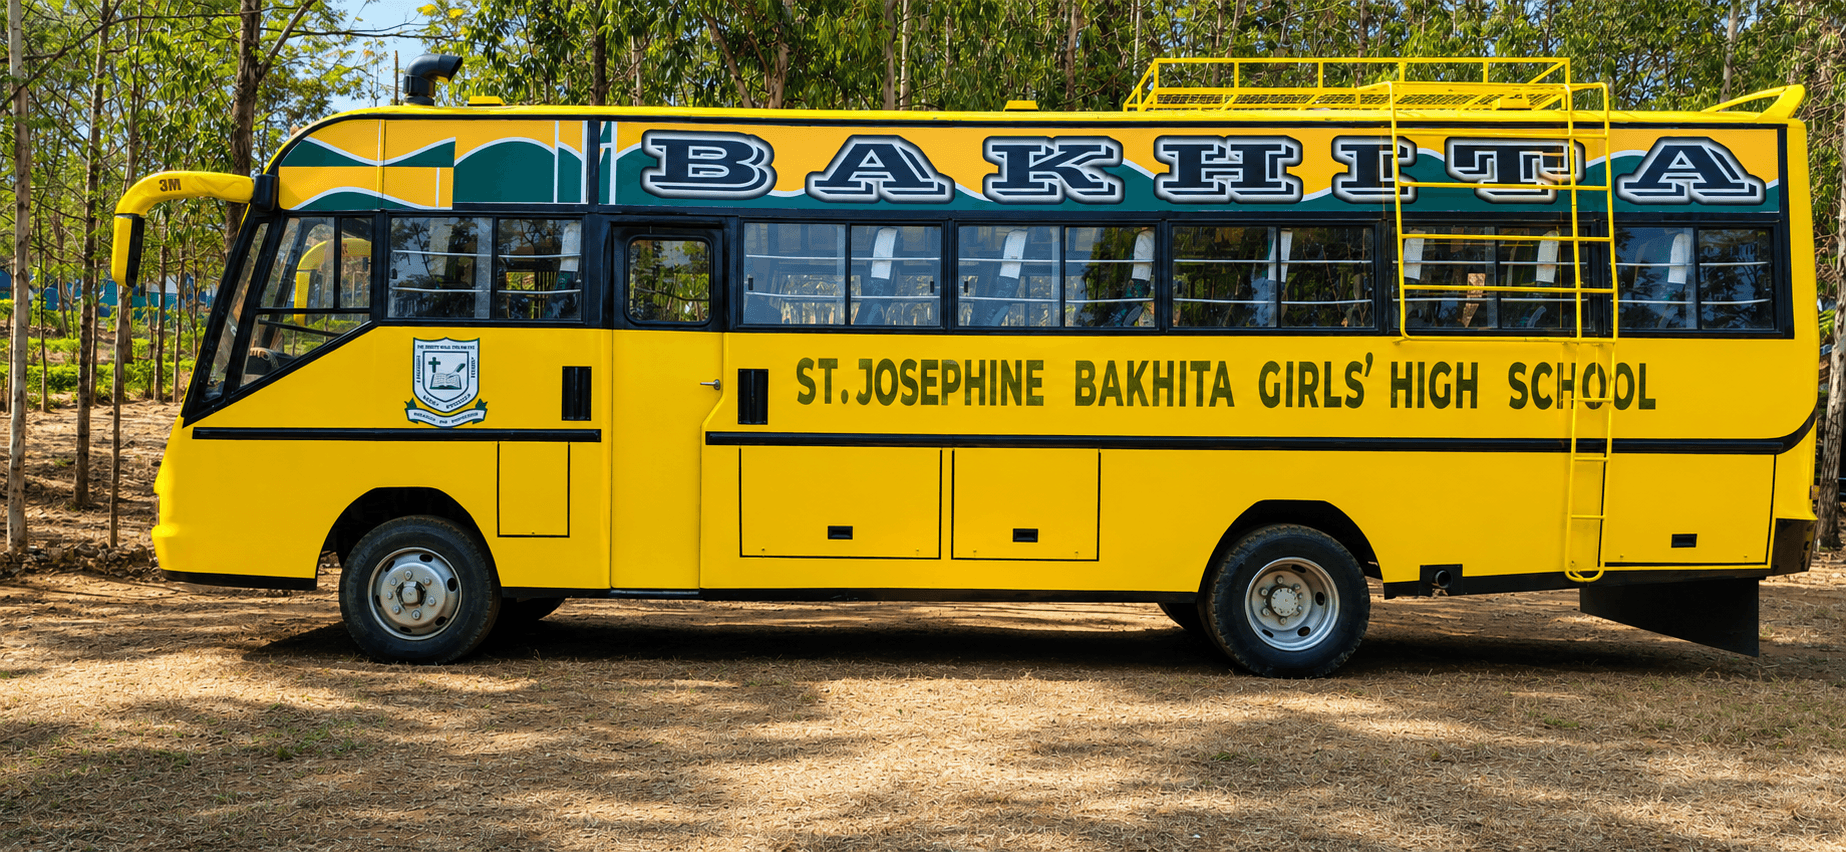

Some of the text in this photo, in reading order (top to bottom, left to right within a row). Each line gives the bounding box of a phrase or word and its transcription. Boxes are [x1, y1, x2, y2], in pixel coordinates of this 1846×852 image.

[159, 178, 181, 192] 3M
[641, 129, 1766, 204] BAKHITA
[1075, 360, 1235, 407] BAKHITA
[1390, 361, 1478, 409] HIGH
[1508, 361, 1656, 410] SCHOOL
